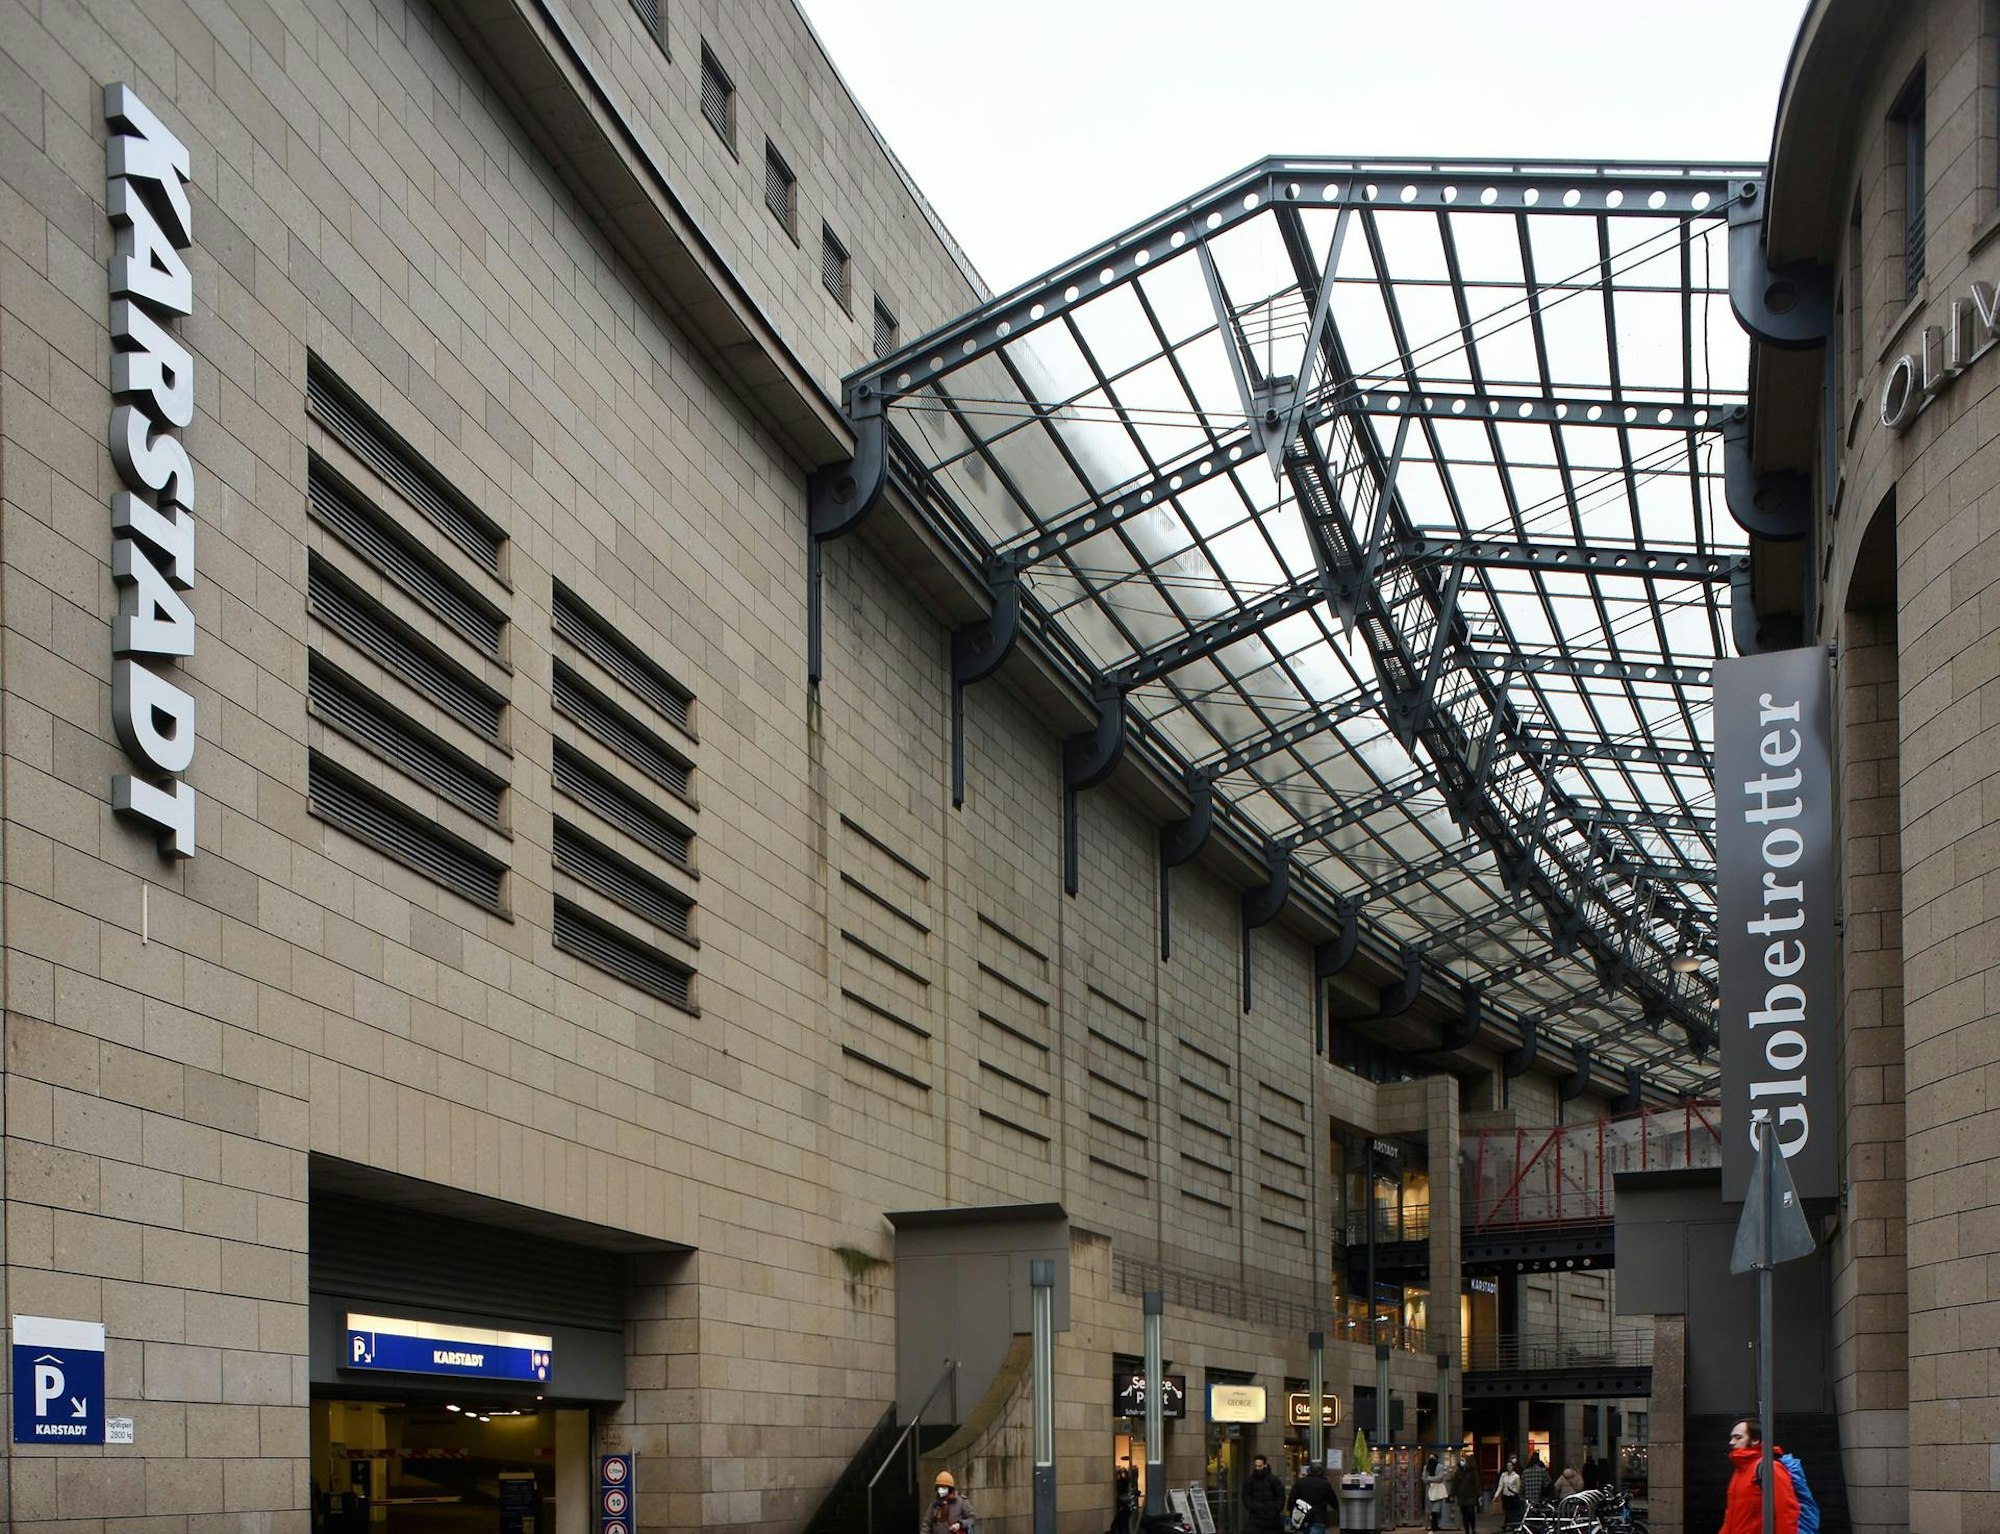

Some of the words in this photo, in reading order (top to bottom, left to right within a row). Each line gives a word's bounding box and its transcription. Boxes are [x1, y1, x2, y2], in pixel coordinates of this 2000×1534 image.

[105, 81, 196, 860] KARSTADT
[1744, 692, 1810, 1159] Globetrotter
[353, 1339, 366, 1362] P
[433, 1350, 484, 1367] KARSTADT
[34, 1364, 66, 1417] P
[35, 1424, 88, 1436] KARSTADT
[110, 1430, 126, 1439] 2800
